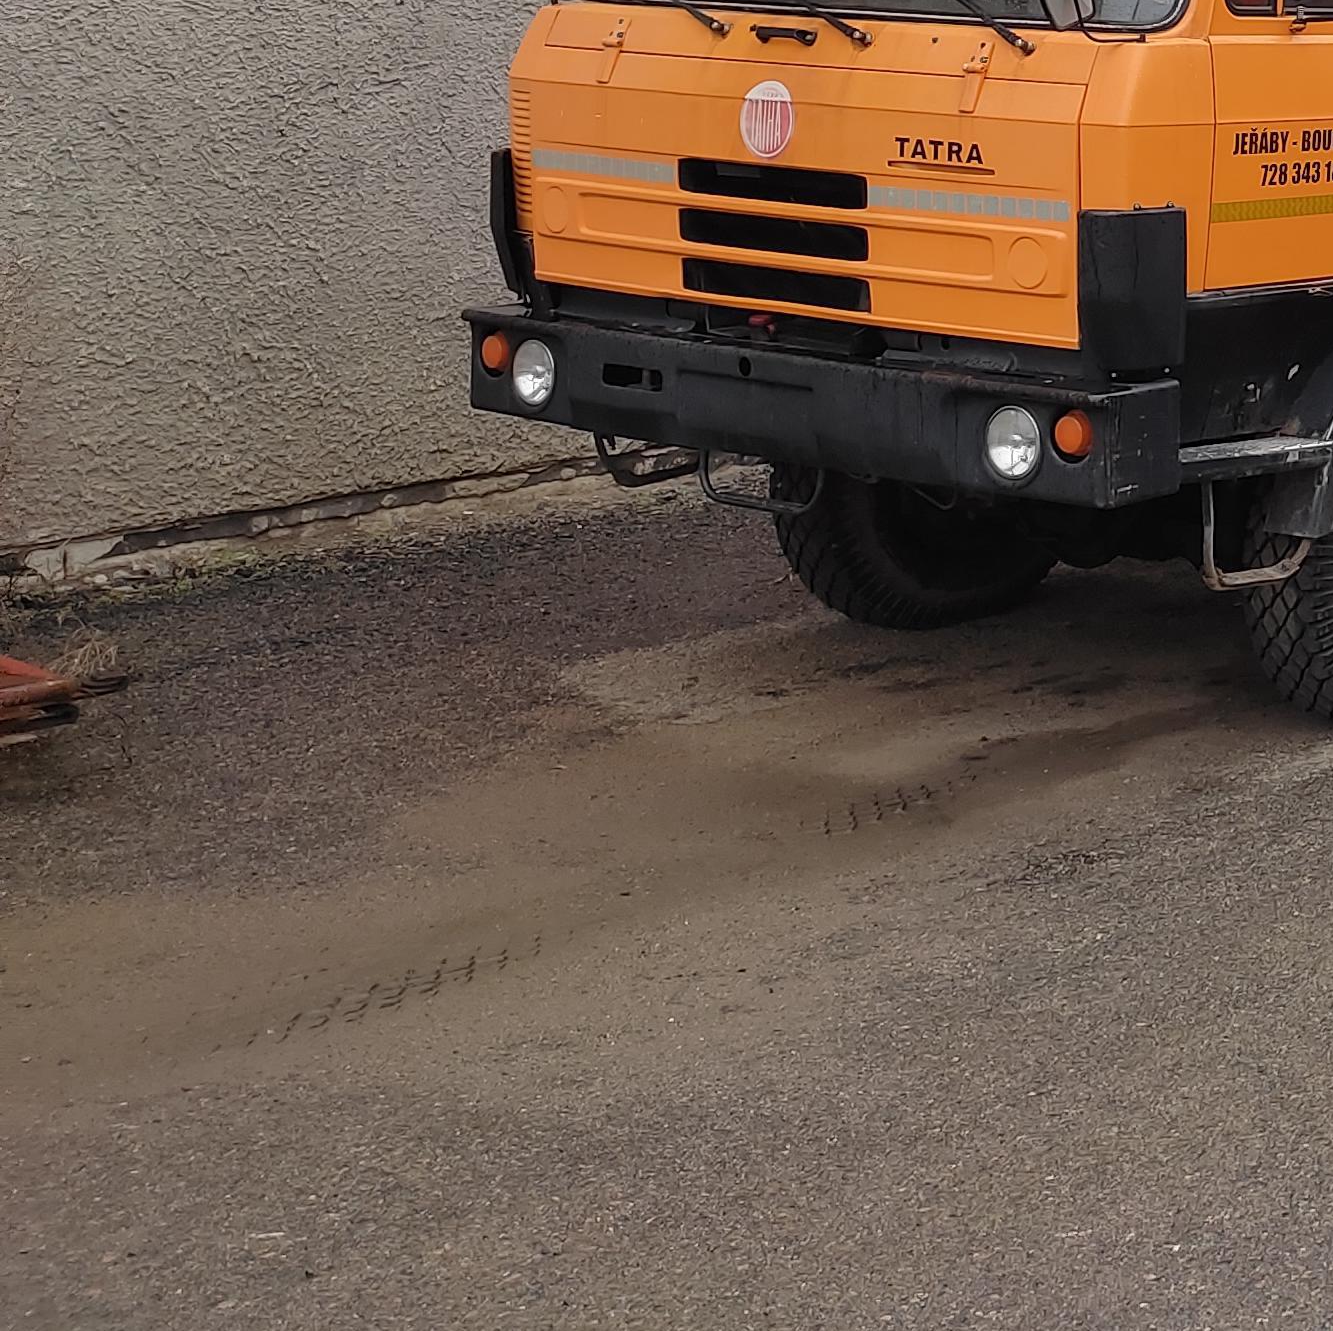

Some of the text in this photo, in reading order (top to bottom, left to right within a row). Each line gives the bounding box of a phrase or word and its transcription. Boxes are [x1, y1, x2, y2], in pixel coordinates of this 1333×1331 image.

[894, 136, 984, 165] TATRA
[1233, 127, 1290, 155] JEŘÁBY
[1260, 163, 1288, 187] 728
[1291, 161, 1321, 185] 343
